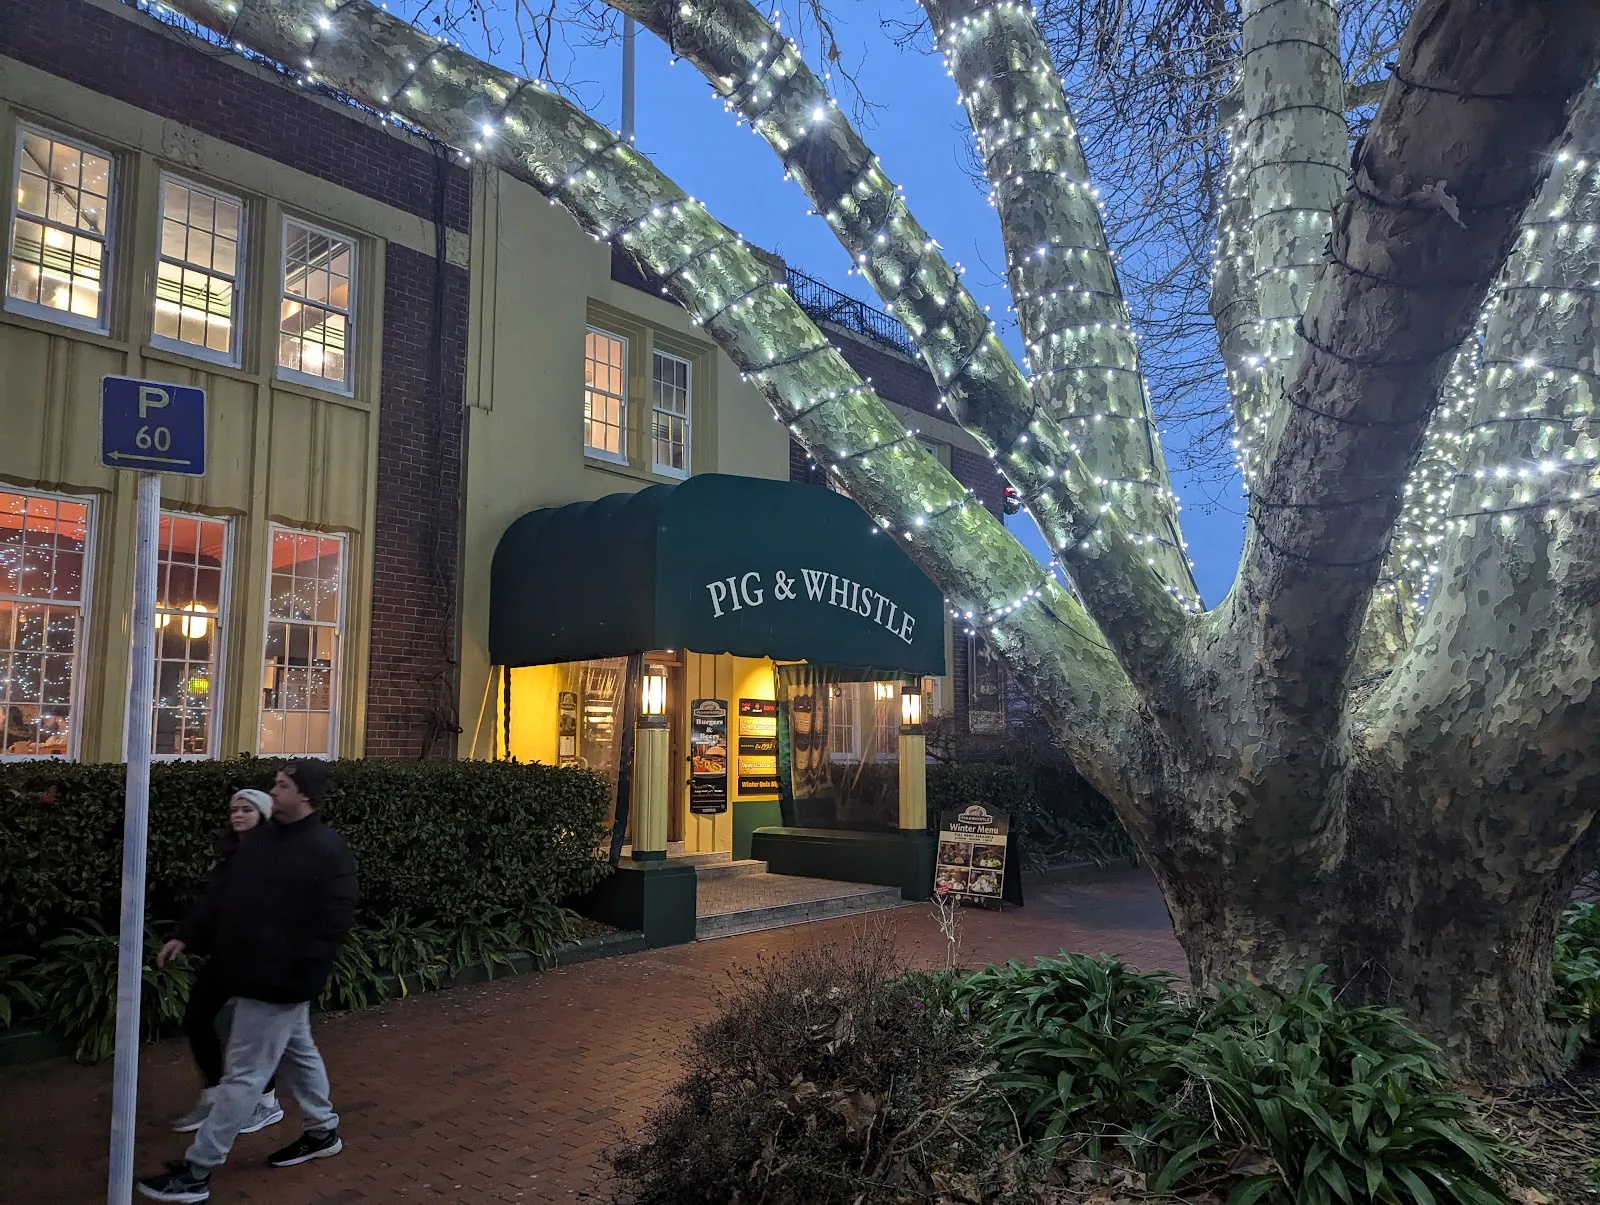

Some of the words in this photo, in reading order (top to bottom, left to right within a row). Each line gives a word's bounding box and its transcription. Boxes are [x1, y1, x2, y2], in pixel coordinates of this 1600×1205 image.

[138, 385, 170, 419] P
[135, 425, 171, 452] 60
[706, 571, 764, 619] PIG
[774, 570, 797, 601] &
[801, 568, 916, 645] WHISTLE
[696, 718, 724, 726] Burgers
[700, 732, 720, 740] Beers
[950, 823, 977, 832] Winter
[977, 825, 999, 834] Menu
